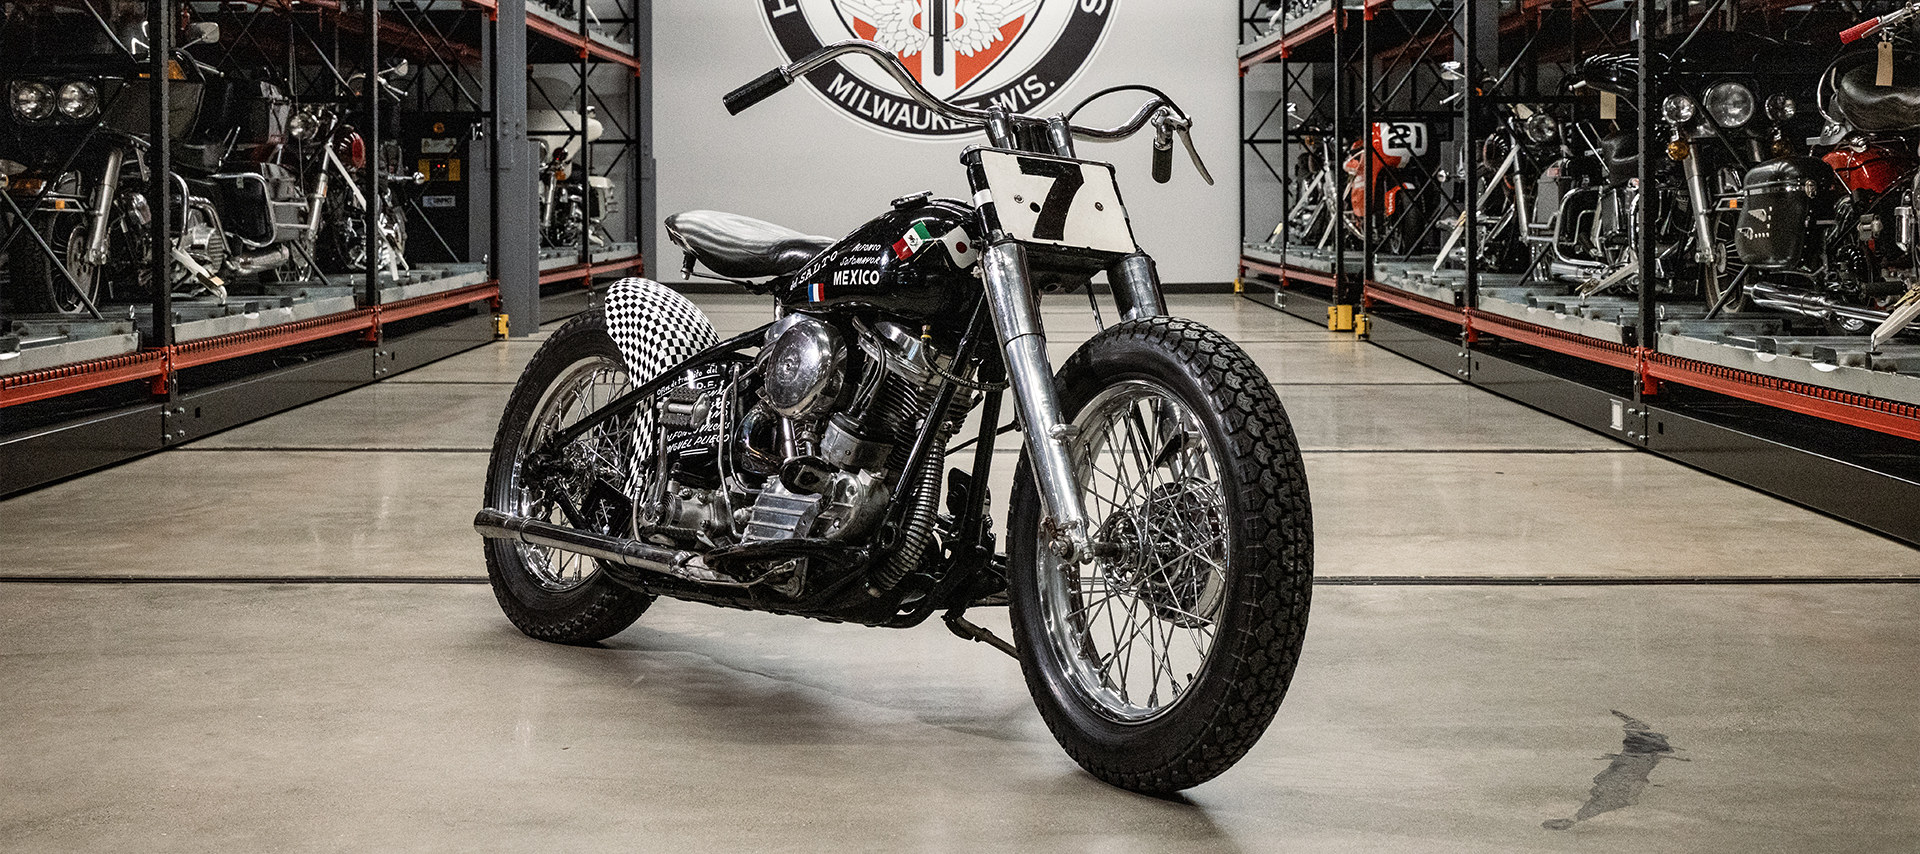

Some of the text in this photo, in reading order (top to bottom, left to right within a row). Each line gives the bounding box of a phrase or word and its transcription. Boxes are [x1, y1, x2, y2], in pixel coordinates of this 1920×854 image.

[1388, 125, 1422, 149] 21
[1017, 156, 1085, 241] 7
[798, 251, 838, 285] SALTO
[833, 269, 880, 286] MEXICO
[696, 380, 717, 390] D.F.
